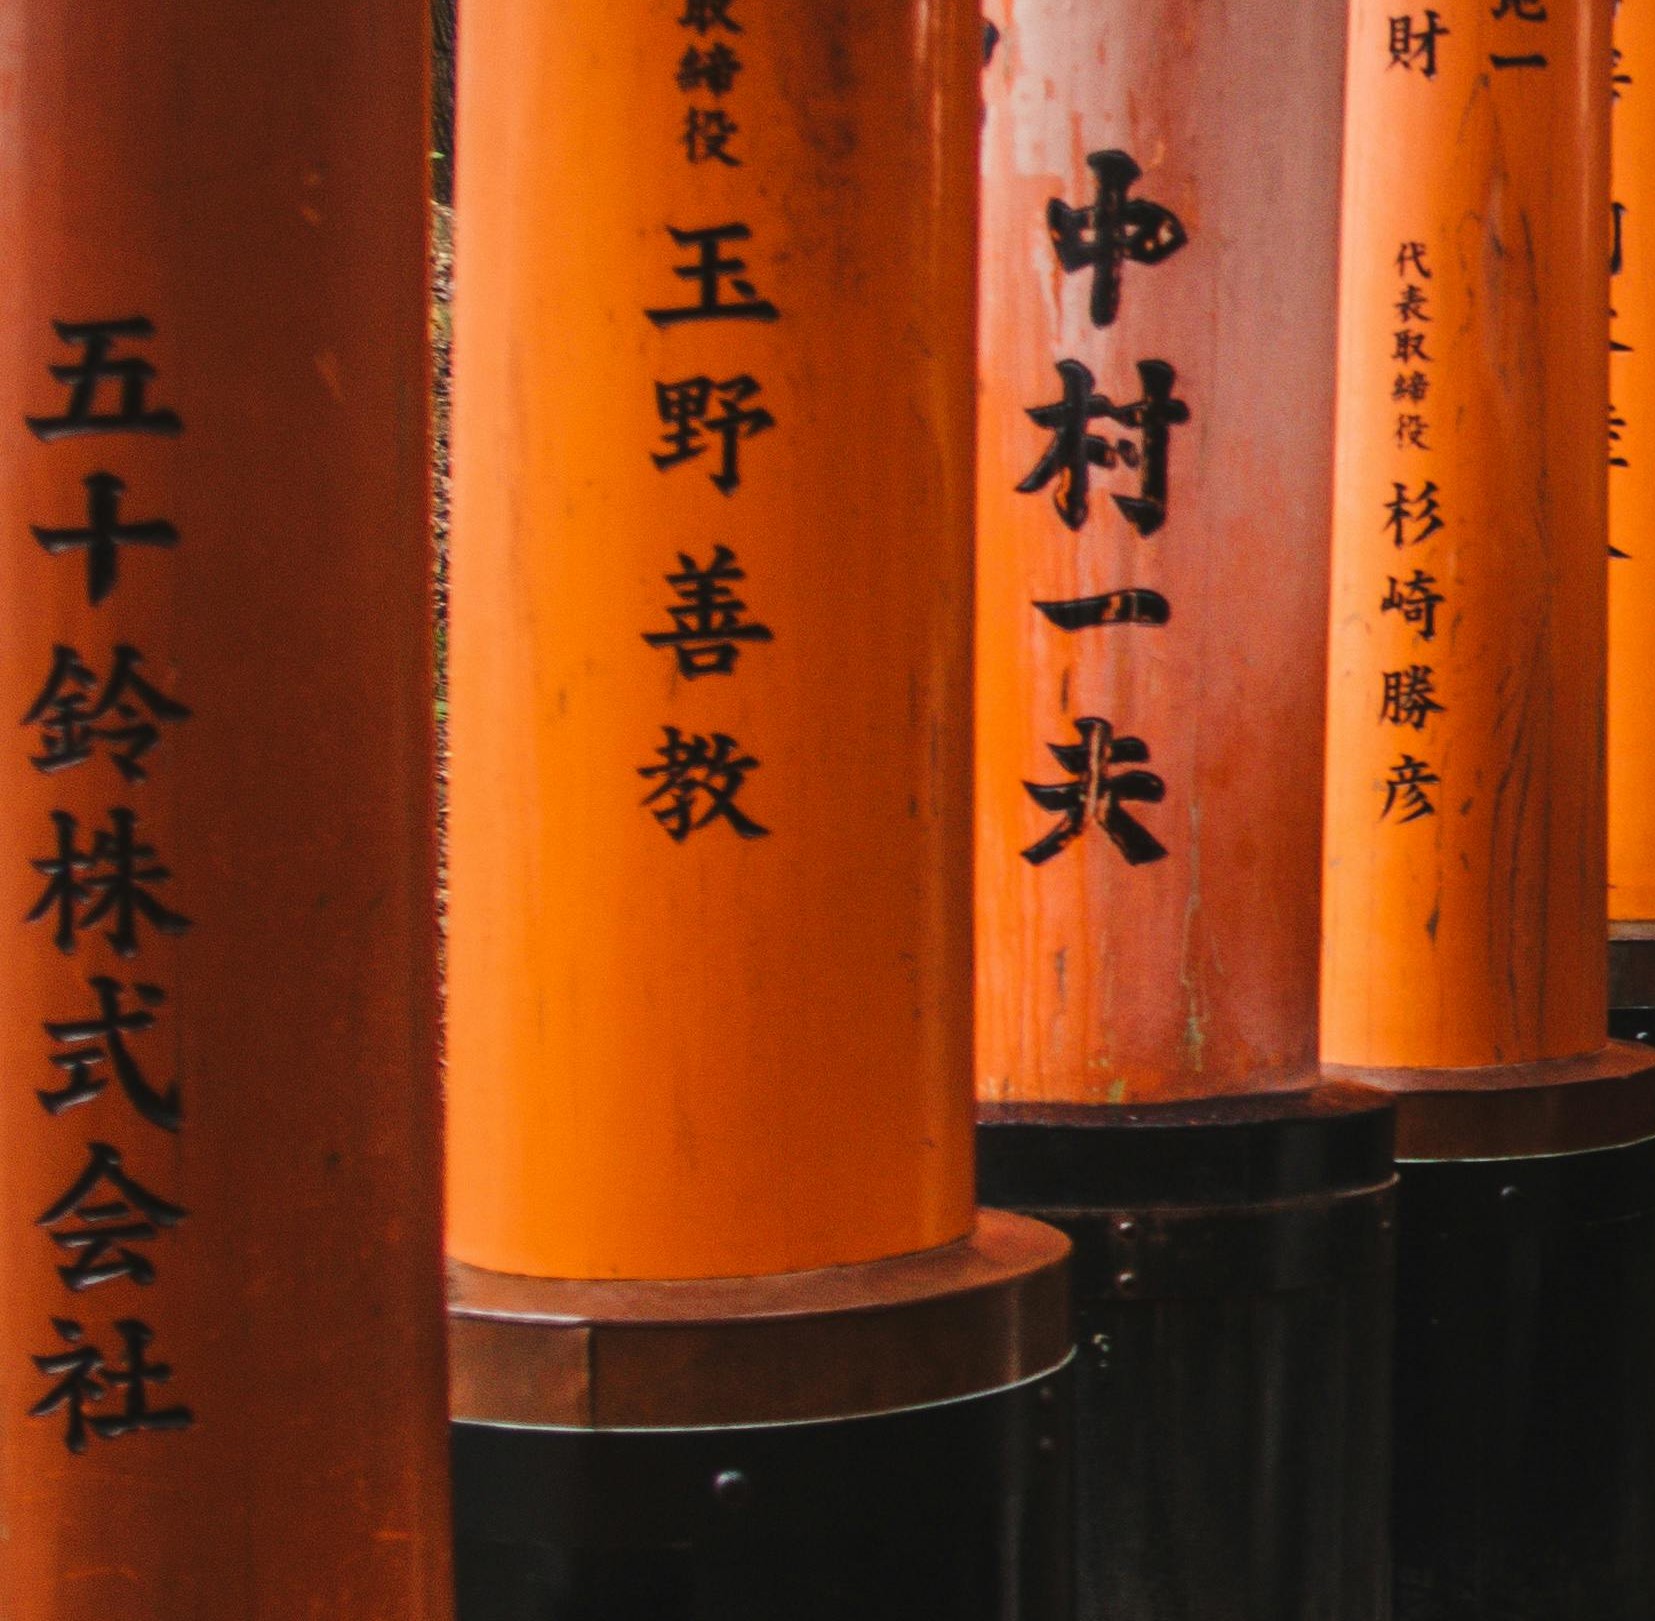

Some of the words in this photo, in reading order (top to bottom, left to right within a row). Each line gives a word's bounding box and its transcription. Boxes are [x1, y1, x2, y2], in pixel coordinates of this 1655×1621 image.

[1384, 9, 1450, 80] 財
[637, 222, 781, 842] 玉野善教
[1016, 149, 1189, 866] 中村一夫
[1391, 240, 1434, 453] 代表取締役
[22, 315, 195, 1454] 五十鈴株式会社
[1381, 480, 1446, 826] 杉崎勝彦
